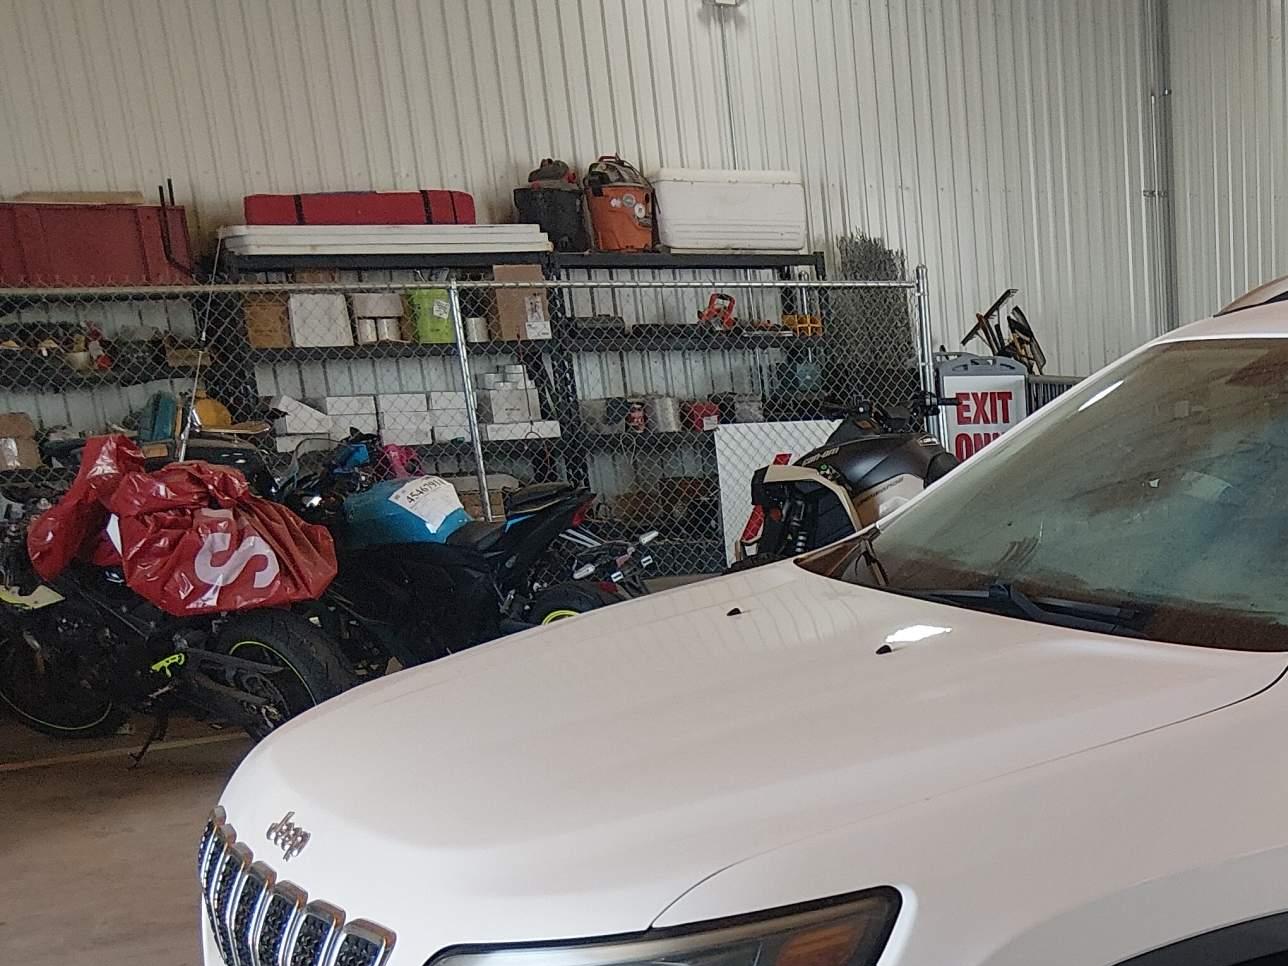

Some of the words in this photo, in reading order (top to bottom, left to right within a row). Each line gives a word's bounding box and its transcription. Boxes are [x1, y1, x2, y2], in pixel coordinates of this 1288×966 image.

[955, 391, 1012, 425] EXIT
[955, 432, 1006, 462] ON
[194, 532, 280, 589] S
